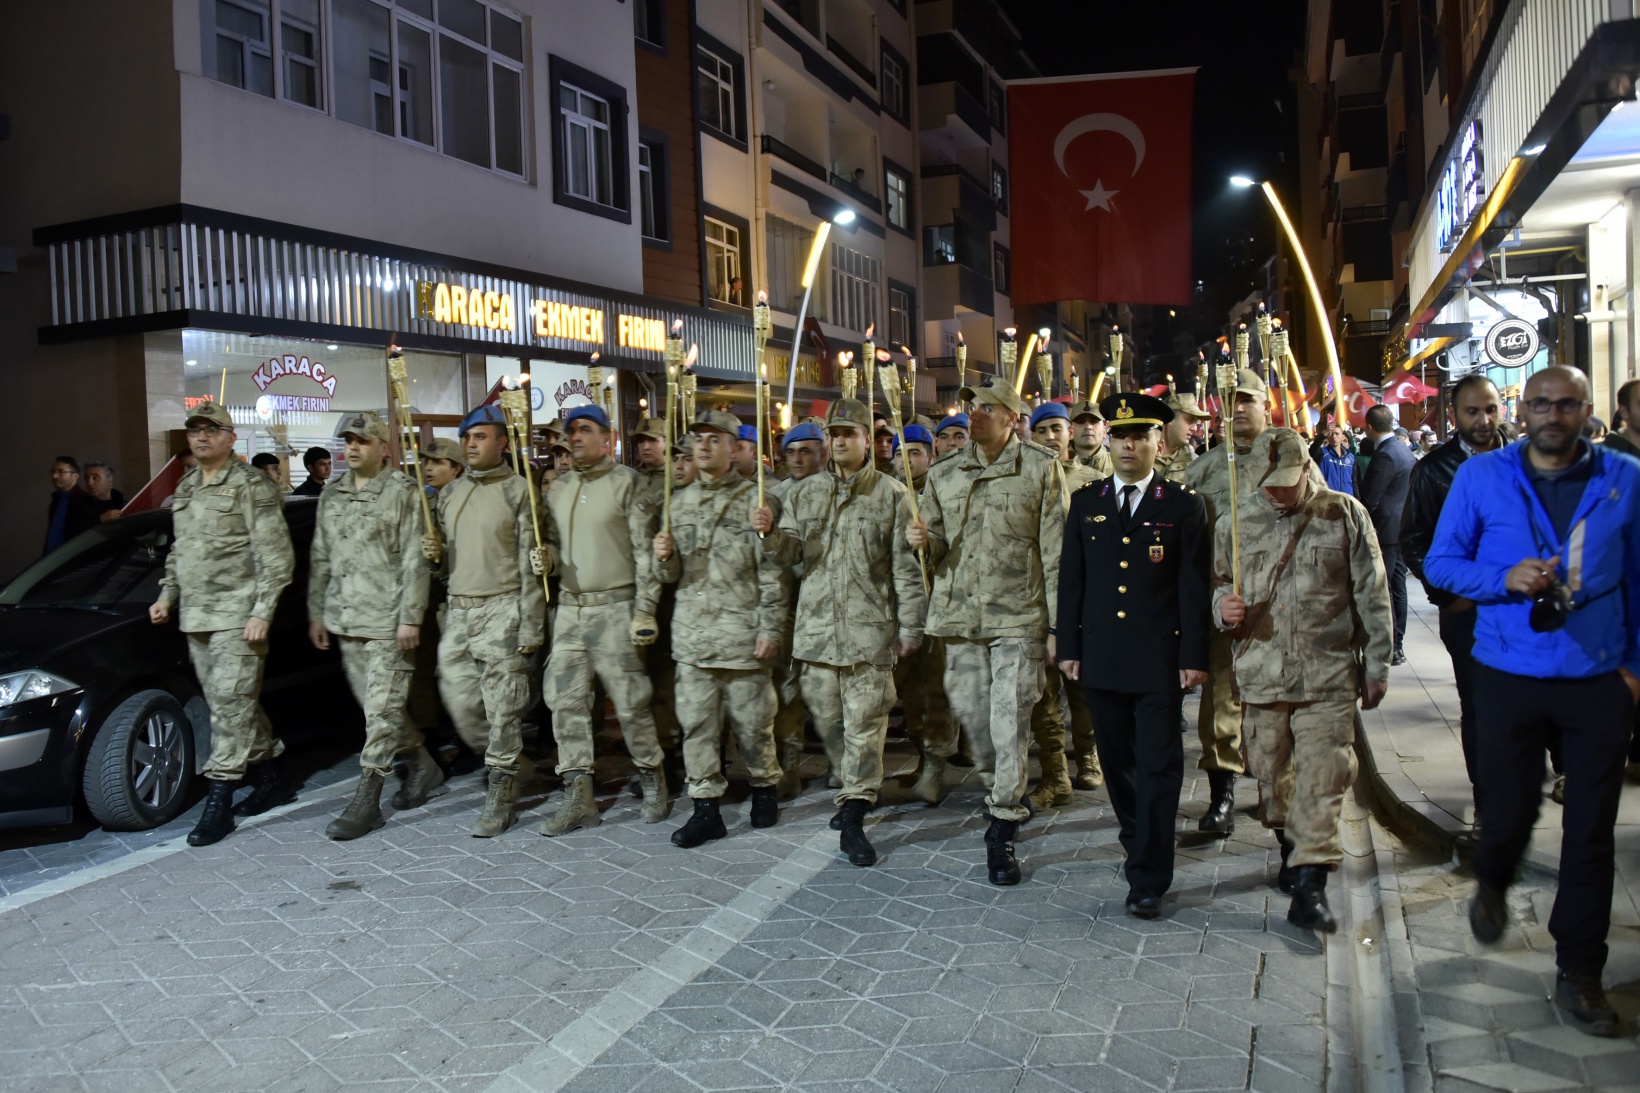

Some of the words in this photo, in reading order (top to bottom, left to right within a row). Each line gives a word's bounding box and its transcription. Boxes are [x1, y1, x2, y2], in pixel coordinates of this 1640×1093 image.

[417, 281, 515, 332] KARACA
[535, 299, 603, 345] EKMEK
[618, 313, 666, 352] FIRINI
[252, 355, 337, 398] KARACA
[554, 379, 595, 407] KARAC
[302, 396, 329, 412] FIRINI
